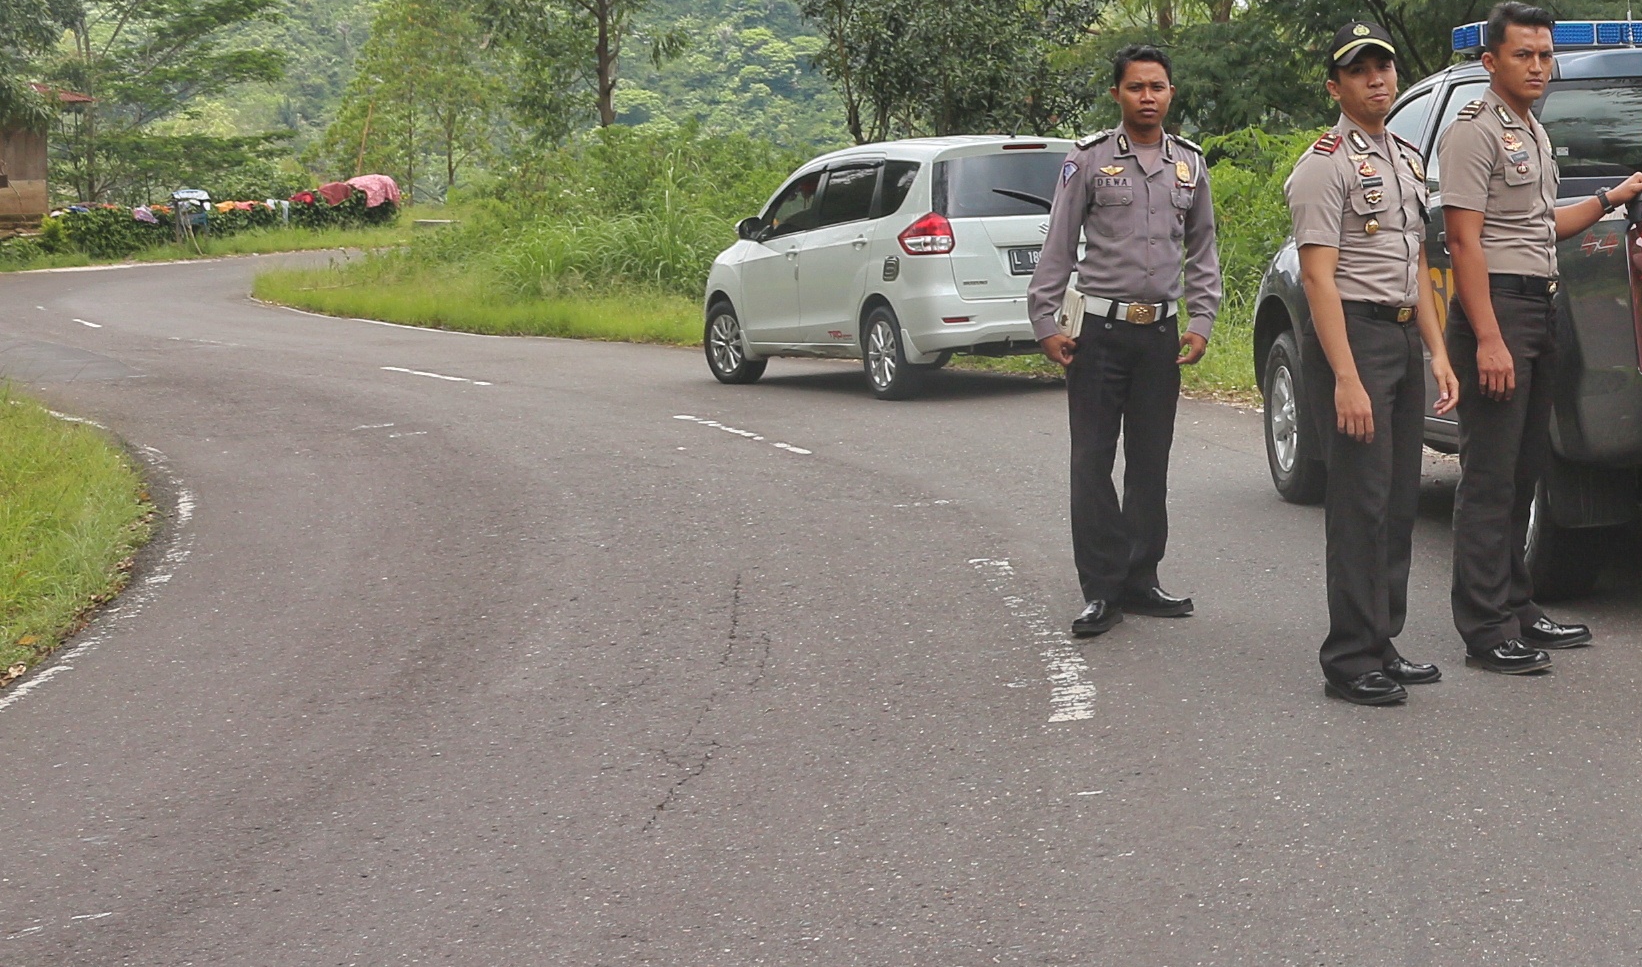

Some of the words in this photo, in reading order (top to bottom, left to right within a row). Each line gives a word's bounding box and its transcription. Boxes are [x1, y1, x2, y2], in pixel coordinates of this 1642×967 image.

[1097, 177, 1128, 187] DEWA
[1013, 251, 1022, 265] L
[1027, 250, 1042, 265] 18
